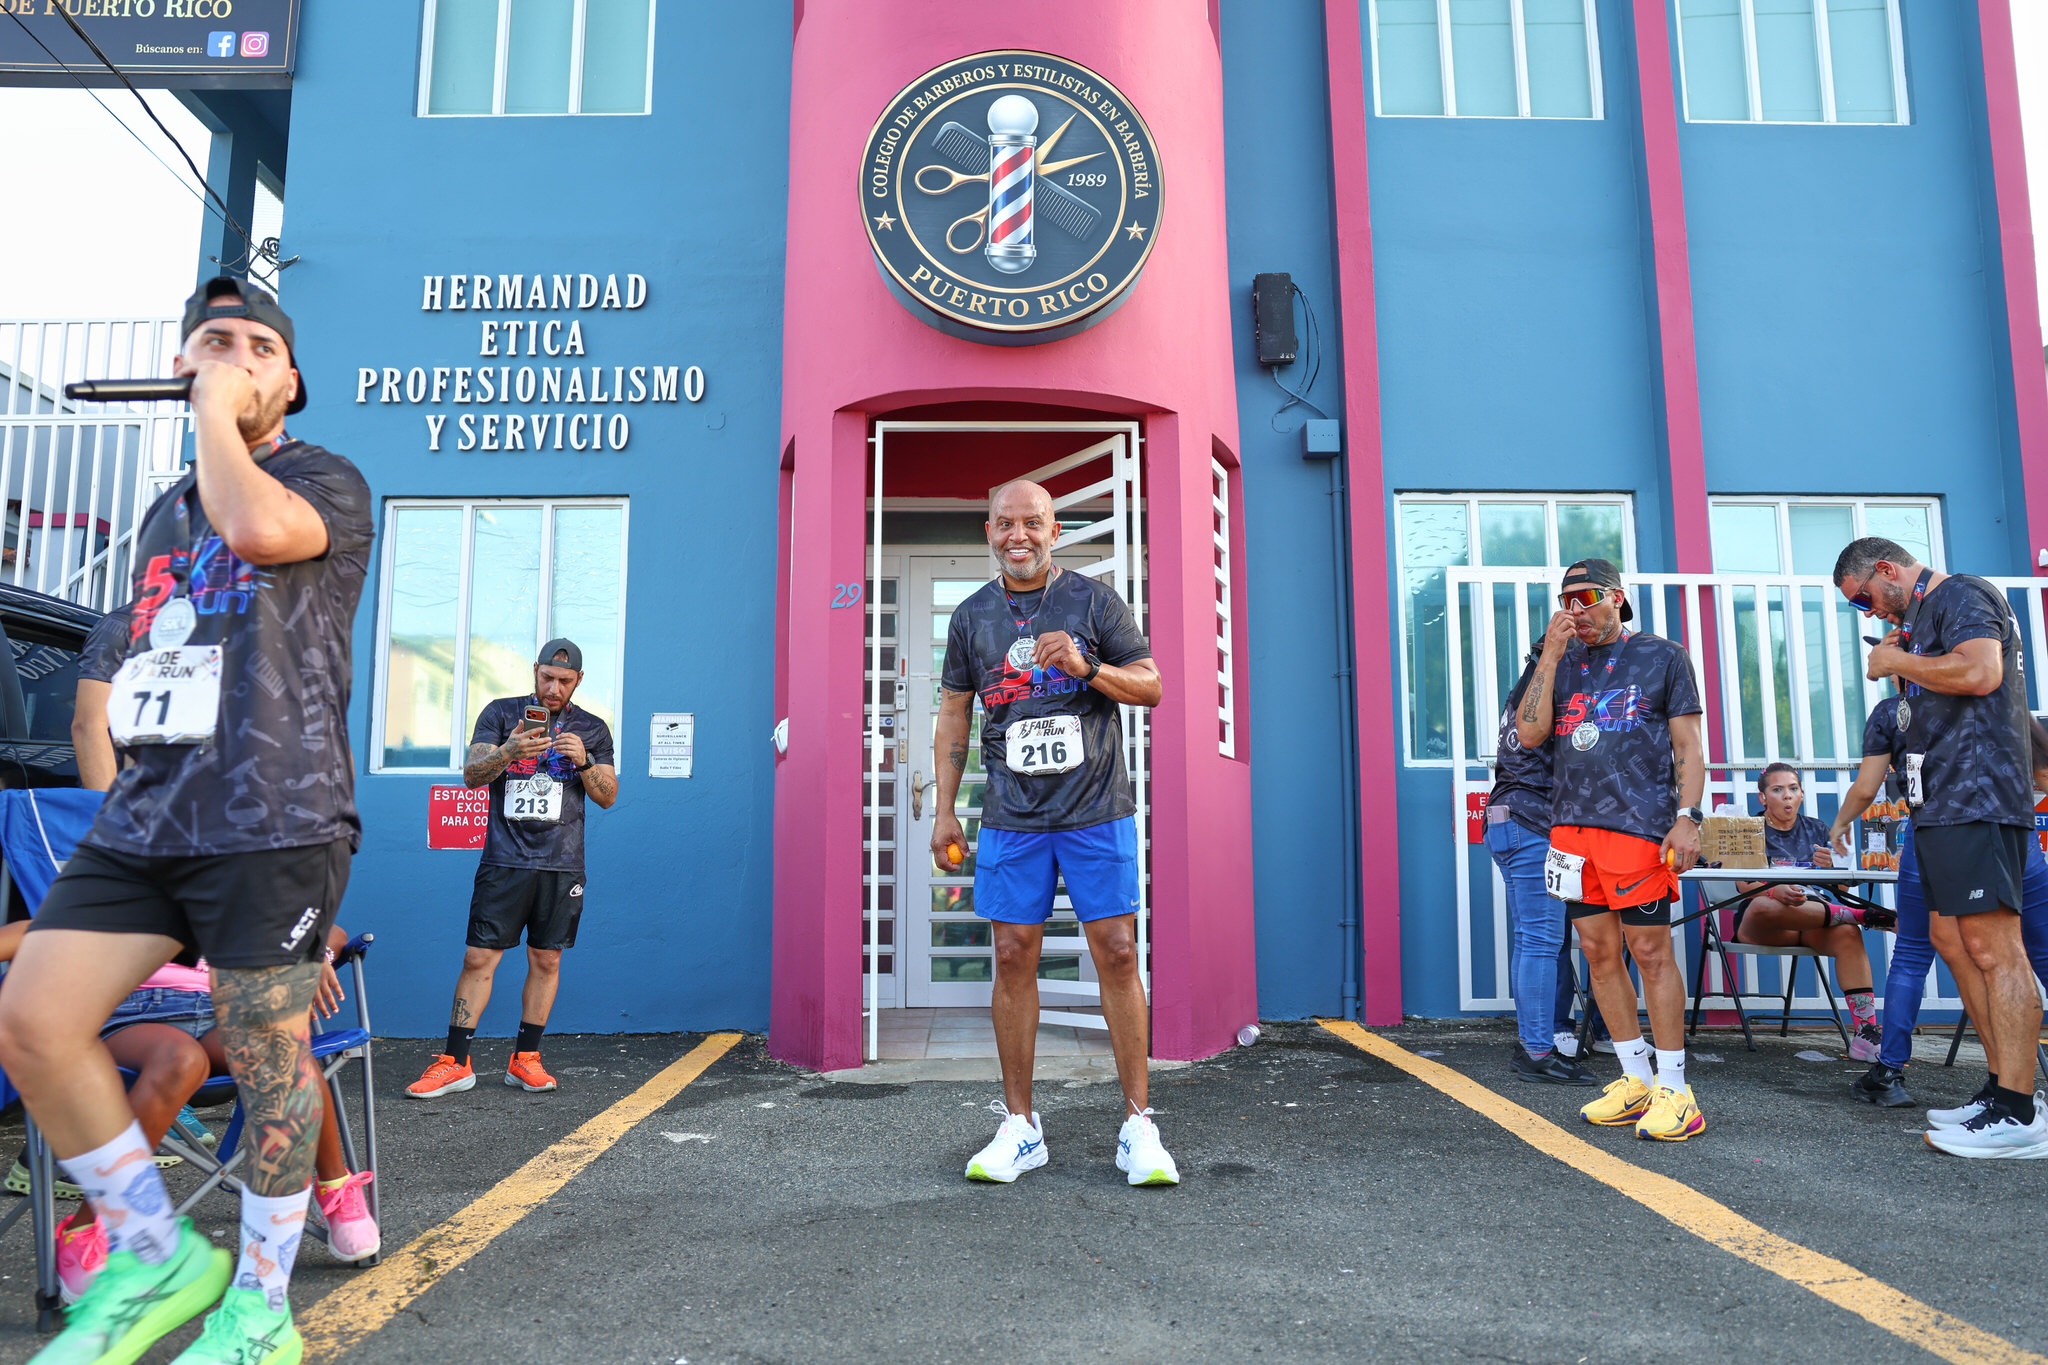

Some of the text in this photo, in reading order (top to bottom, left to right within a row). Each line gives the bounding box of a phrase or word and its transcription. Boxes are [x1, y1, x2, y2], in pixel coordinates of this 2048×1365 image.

[43, 0, 156, 18] PUERTO
[163, 0, 233, 18] RICO
[135, 43, 203, 55] Búscanos en:
[872, 128, 902, 198] COLEGIO
[894, 106, 918, 129] DE
[912, 65, 996, 111] BARBEROS
[998, 64, 1010, 78] Y
[1013, 64, 1101, 105] ESTILISTAS
[1097, 99, 1122, 122] EN
[1066, 173, 1107, 187] 1989
[421, 273, 648, 311] HERMANDAD
[908, 264, 1109, 318] PUERTO RICO
[479, 319, 586, 357] ETICA
[355, 365, 706, 404] PROFESIONALISMO
[425, 413, 630, 451] Y SERVICIO
[831, 583, 862, 609] 29
[158, 666, 196, 679] RUN
[984, 679, 1088, 709] FADE & RUN
[133, 690, 172, 727] 71
[1030, 719, 1056, 731] FADE
[1036, 726, 1066, 737] & RUN
[1555, 723, 1579, 736] ADE
[656, 746, 687, 755] AVISO
[1021, 741, 1067, 767] 216
[434, 789, 489, 801] ESTACIO
[456, 802, 489, 813] EXCL
[514, 797, 549, 815] 213
[441, 815, 488, 827] PARA CO
[468, 835, 482, 844] LEY
[1551, 850, 1567, 861] FADE
[1557, 860, 1572, 871] RUN
[1547, 869, 1562, 892] 51
[1968, 889, 1984, 900] NB
